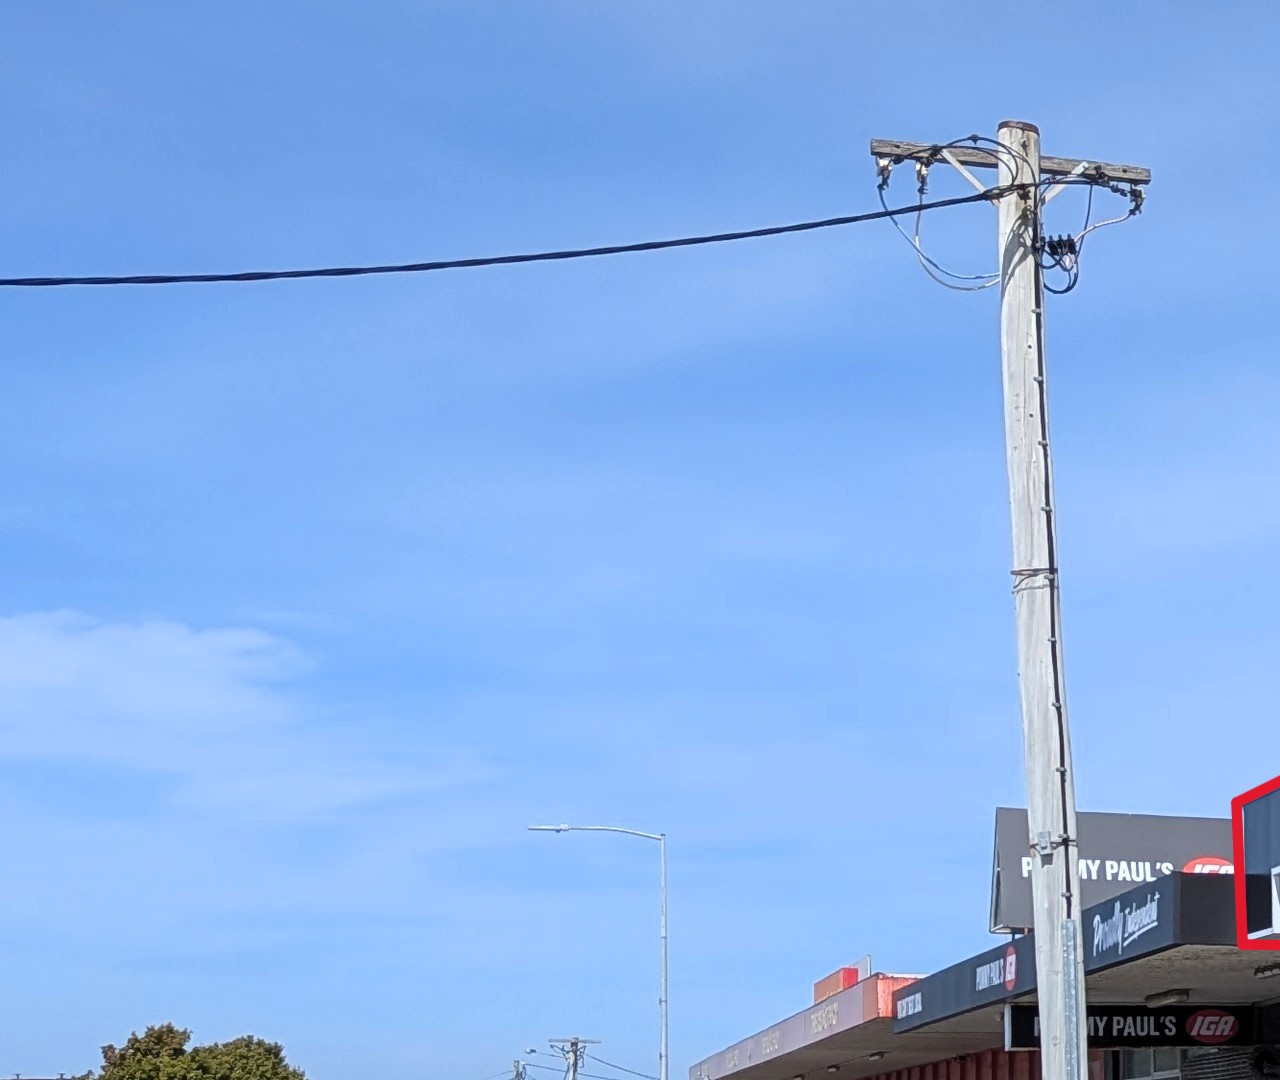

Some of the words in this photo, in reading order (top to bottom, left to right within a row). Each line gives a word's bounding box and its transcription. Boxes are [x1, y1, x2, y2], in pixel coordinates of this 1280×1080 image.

[1105, 860, 1174, 882] PAUL'S
[1112, 1015, 1177, 1037] PAUL'S
[1190, 1015, 1235, 1037] IGA
